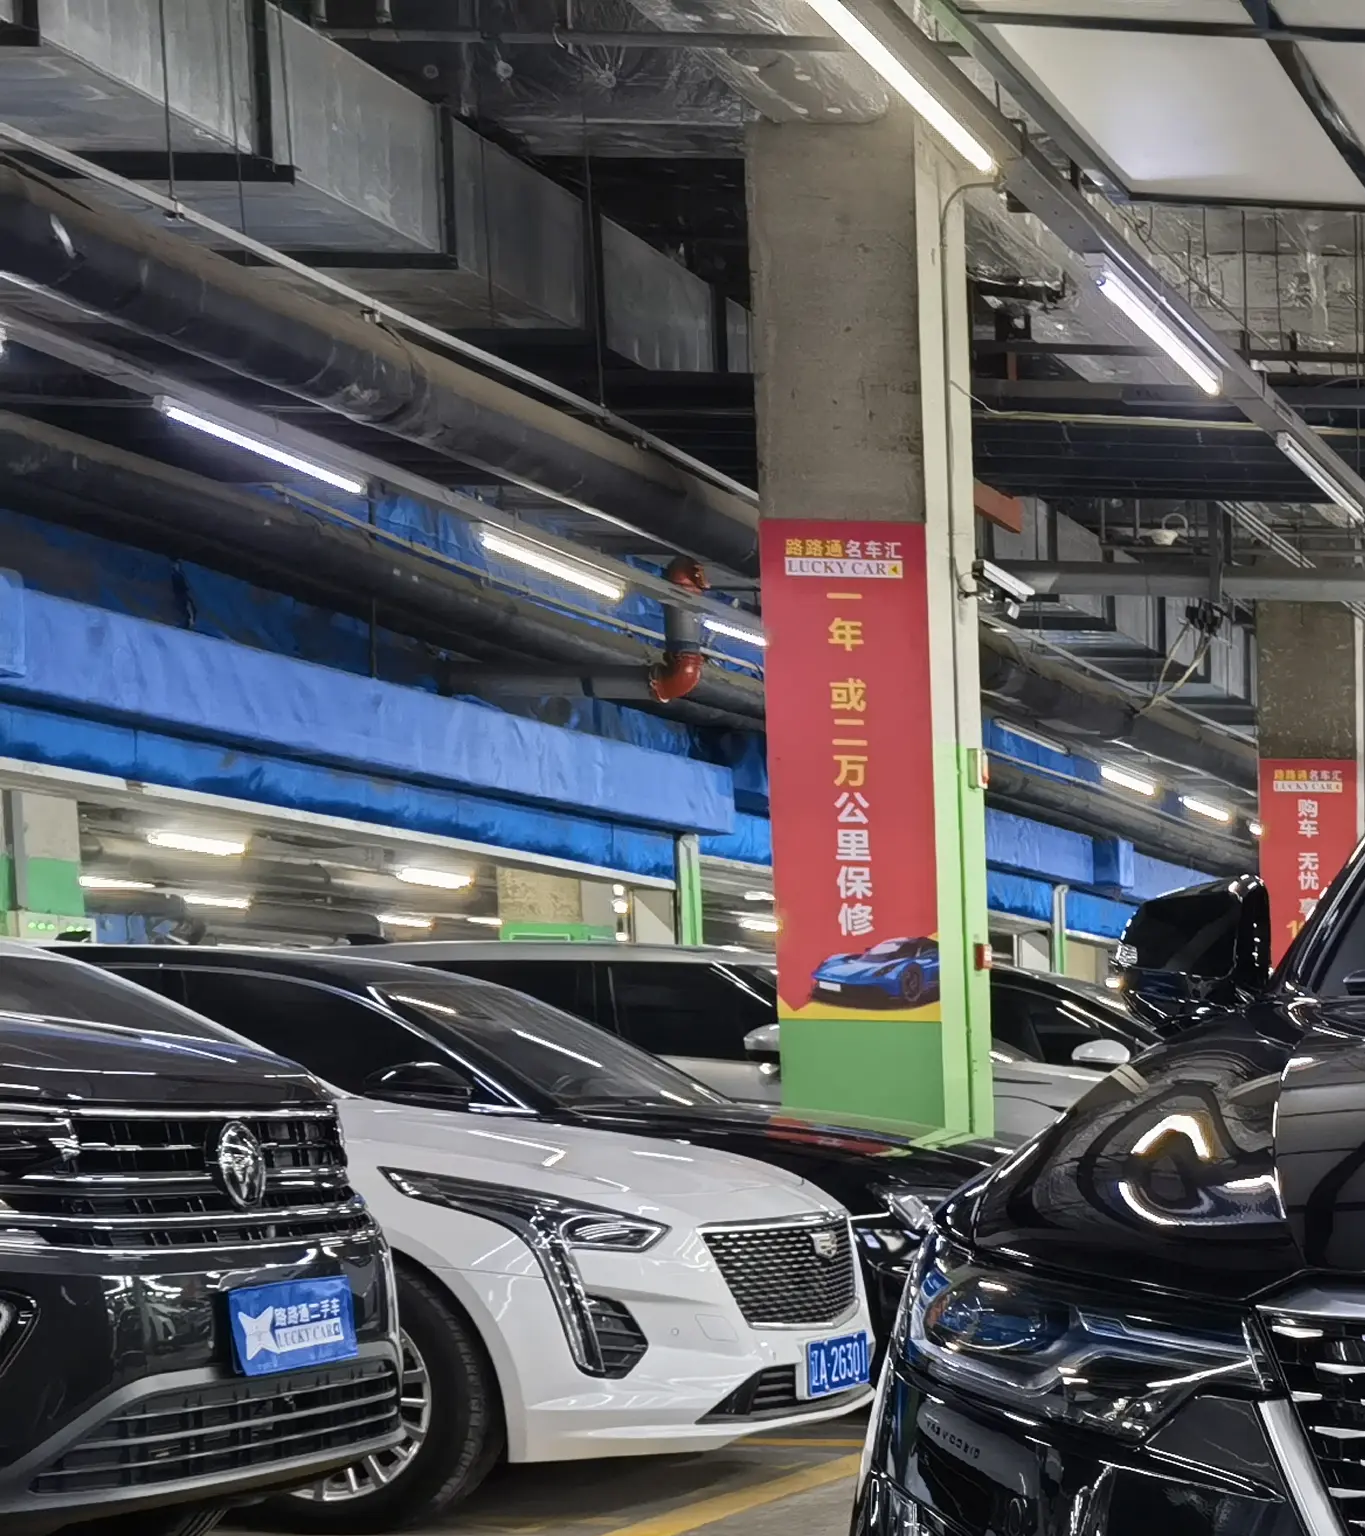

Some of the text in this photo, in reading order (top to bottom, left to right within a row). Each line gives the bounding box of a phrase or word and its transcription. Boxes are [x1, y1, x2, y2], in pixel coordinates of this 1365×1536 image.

[785, 538, 903, 559] 路路通名车汇
[787, 560, 886, 576] LUCKY CAR
[274, 1298, 341, 1327] 路路通二手车
